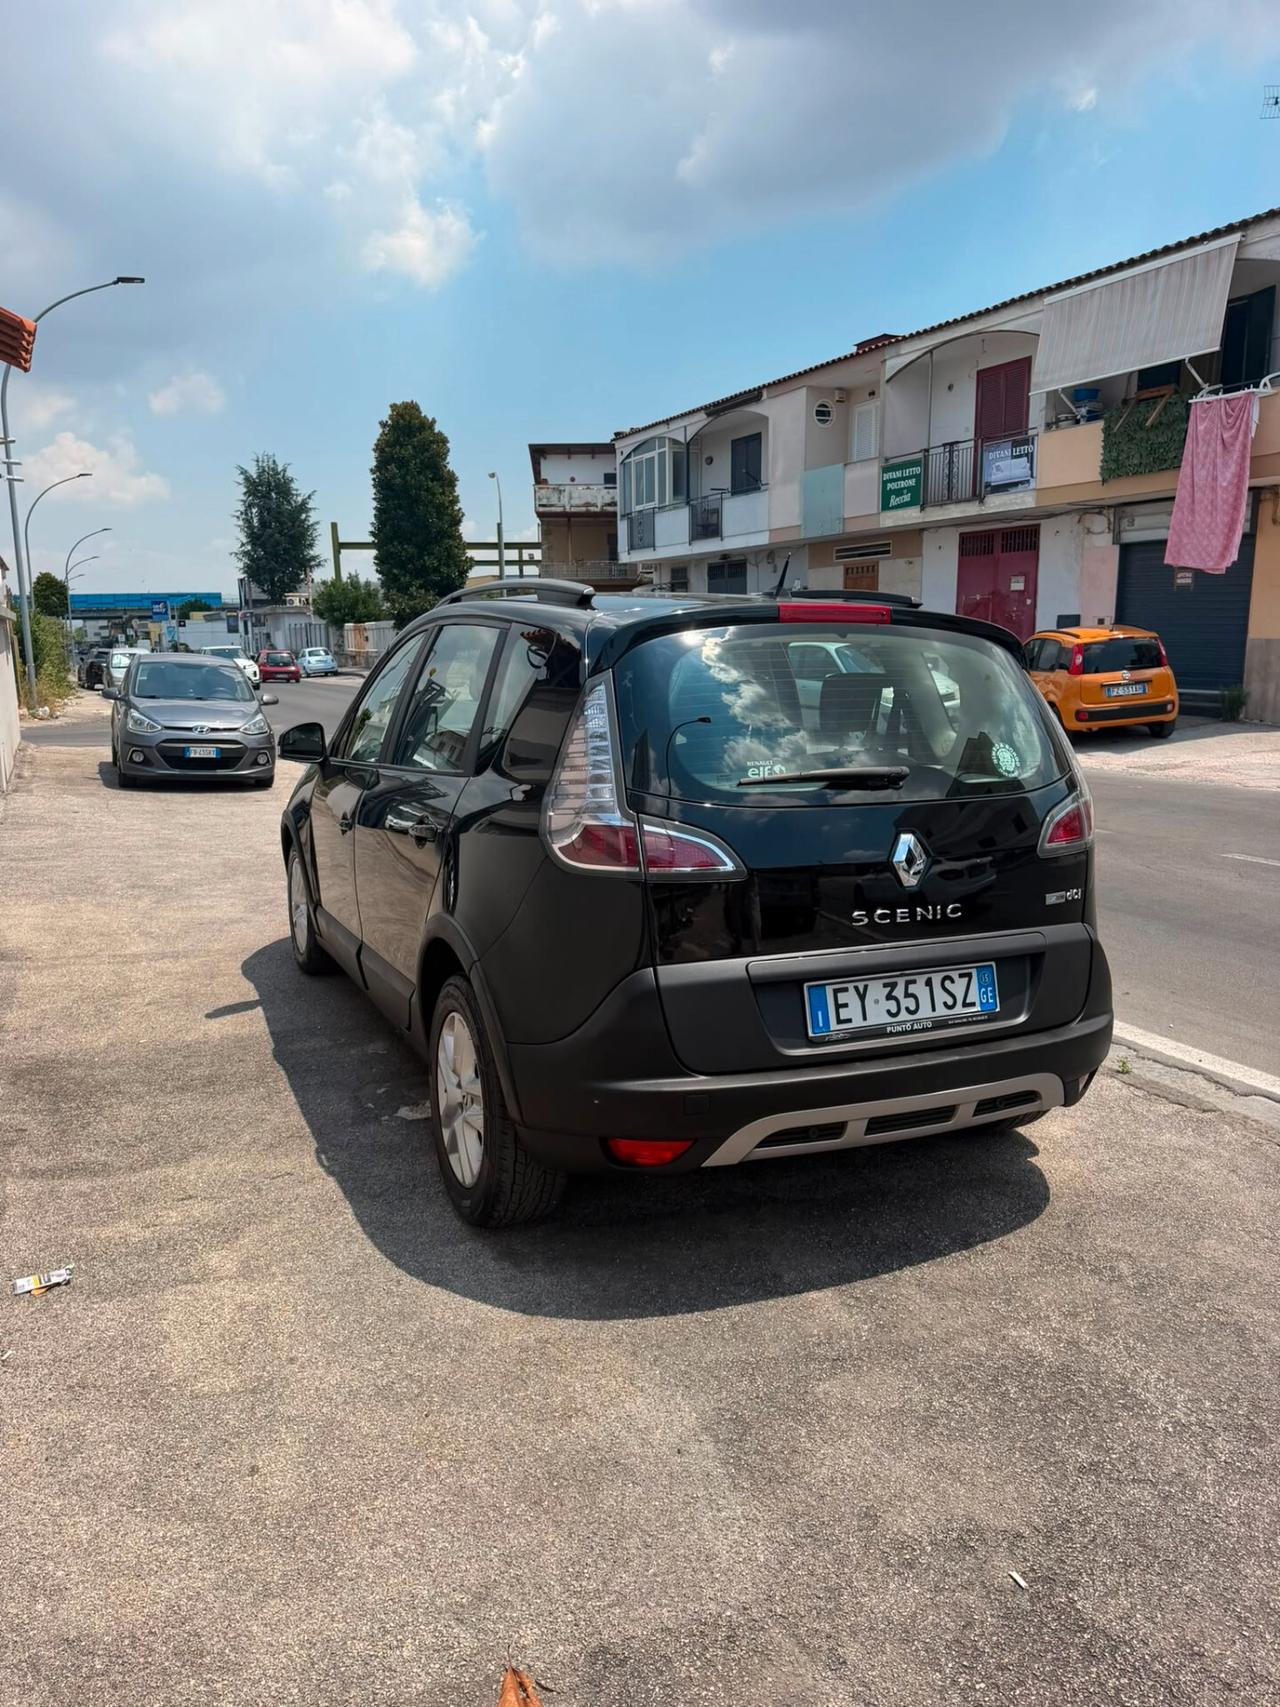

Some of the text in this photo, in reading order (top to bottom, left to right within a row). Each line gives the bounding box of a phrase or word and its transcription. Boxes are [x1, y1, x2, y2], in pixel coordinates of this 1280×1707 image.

[988, 445, 1034, 460] DIVANI LETTO
[883, 466, 921, 481] DIVANI LETTO
[886, 479, 916, 491] POLTRONE
[747, 765, 772, 778] elf
[851, 903, 962, 926] SCENIC
[980, 986, 994, 1003] GE
[886, 1021, 933, 1034] PUNTO AUTO
